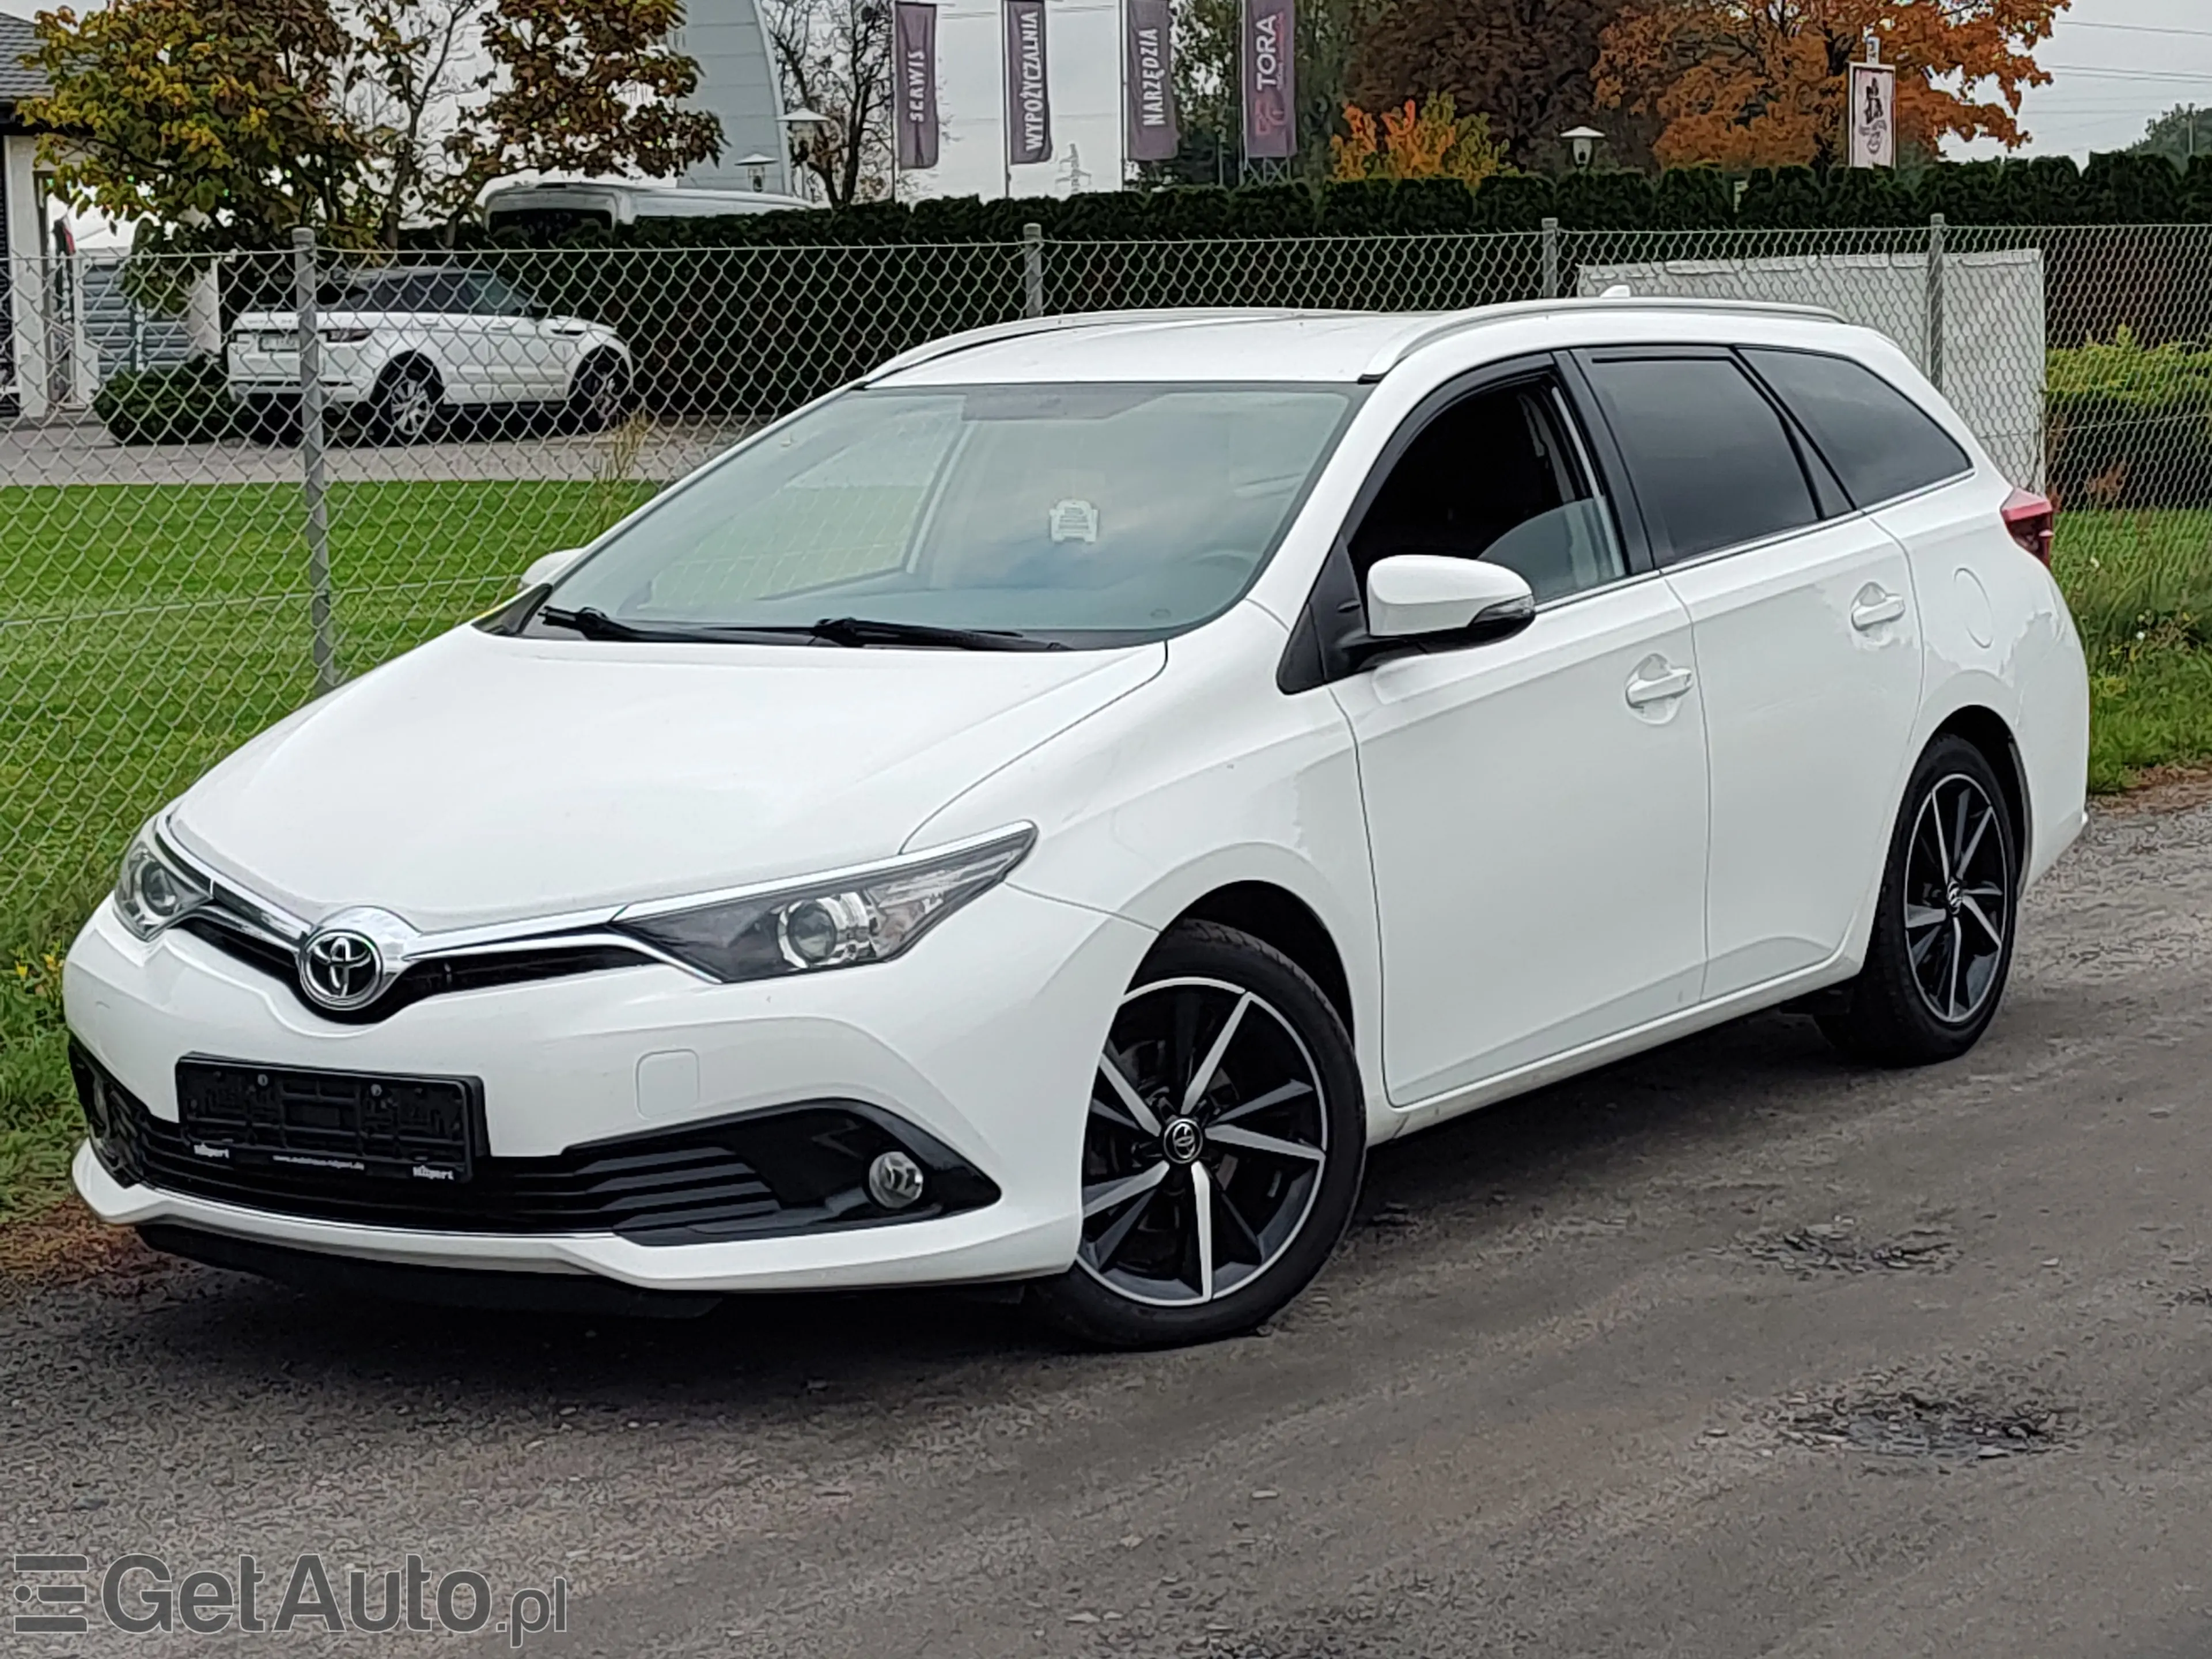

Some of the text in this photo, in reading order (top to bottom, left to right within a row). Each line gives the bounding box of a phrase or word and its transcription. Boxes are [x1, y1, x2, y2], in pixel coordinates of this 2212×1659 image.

[907, 50, 925, 123] SERWIS
[1019, 10, 1044, 152] WYPOŻYCZALNIA
[1138, 28, 1166, 126] NARZĘDZIA
[1255, 14, 1277, 91] TORA
